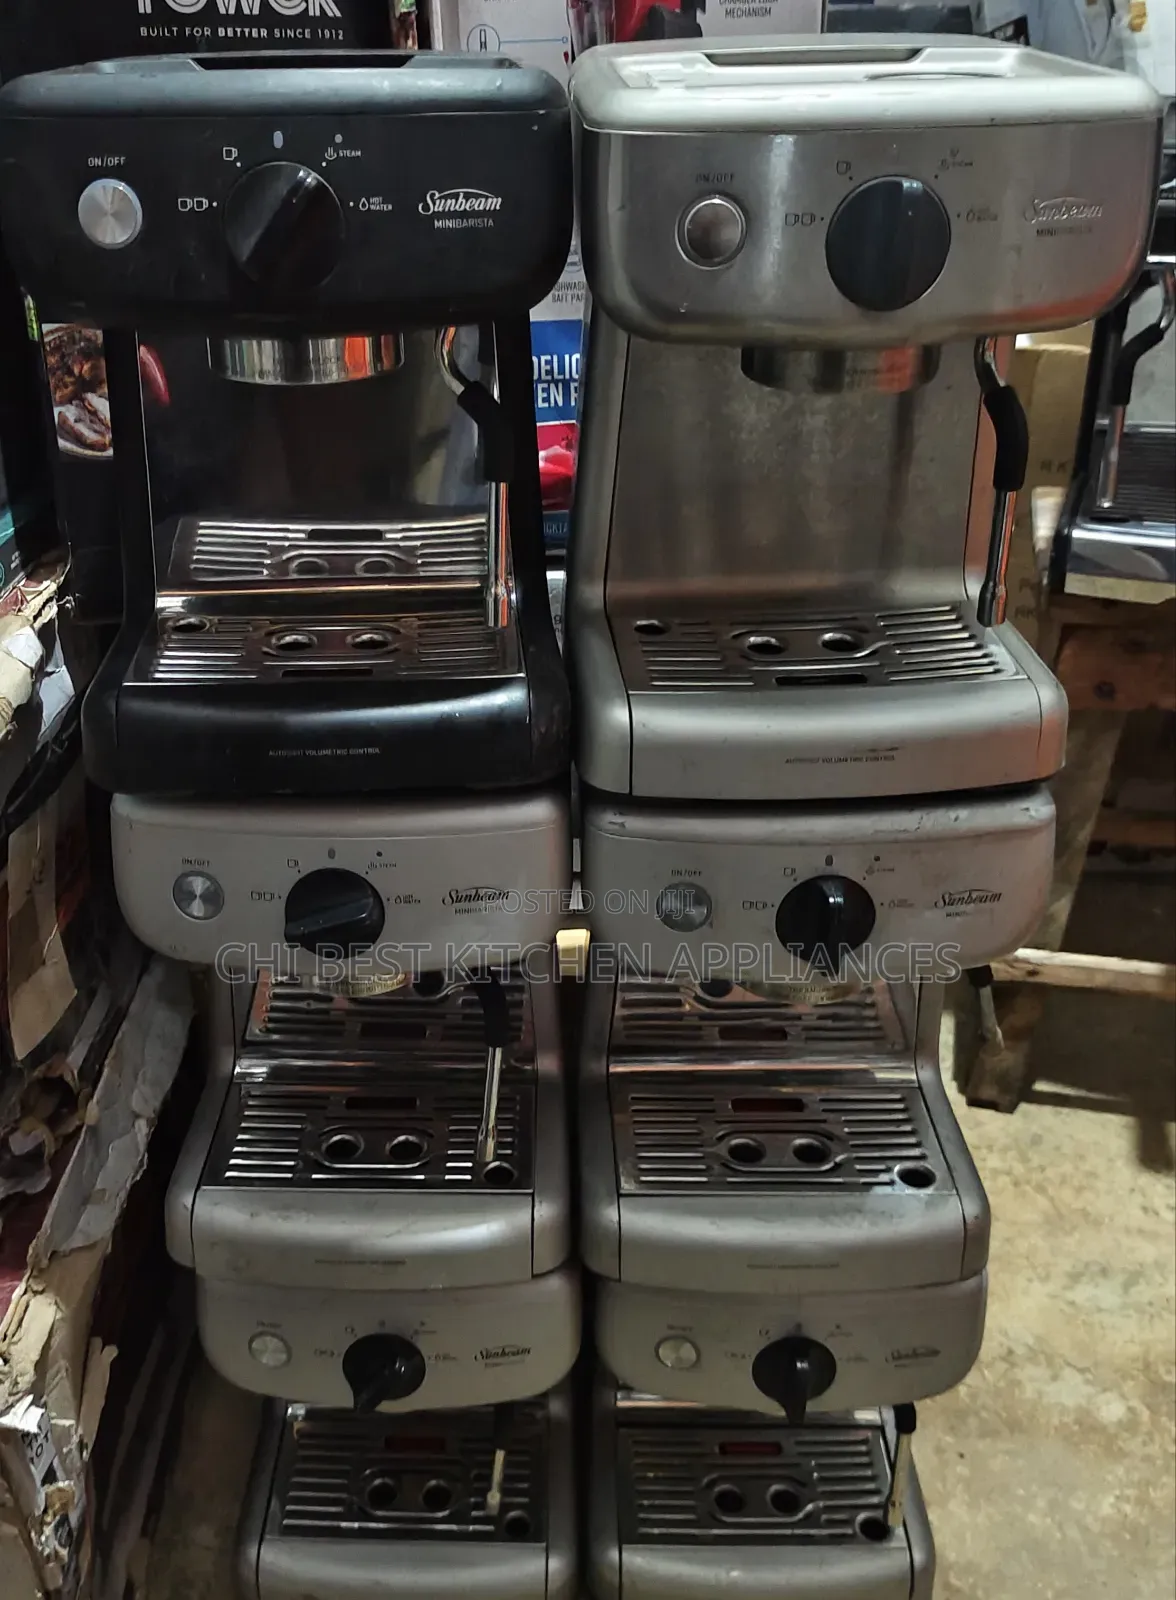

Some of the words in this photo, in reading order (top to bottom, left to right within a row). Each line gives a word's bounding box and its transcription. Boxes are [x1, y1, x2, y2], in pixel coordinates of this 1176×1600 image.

[724, 6, 772, 19] MECHANISM
[139, 26, 178, 37] BUILT
[184, 26, 212, 38] FOR
[217, 27, 268, 39] BETTER
[273, 28, 311, 39] SINCE
[317, 28, 344, 41] 1912
[338, 149, 362, 158] STEAM
[87, 155, 126, 168] ON/OFF
[369, 196, 383, 204] HOT
[418, 188, 503, 215] Sunbeam
[369, 203, 393, 212] WATER
[433, 217, 494, 230] MINIBARISTA
[441, 886, 510, 906] Sunbeam
[933, 888, 1003, 909] Sunbeam
